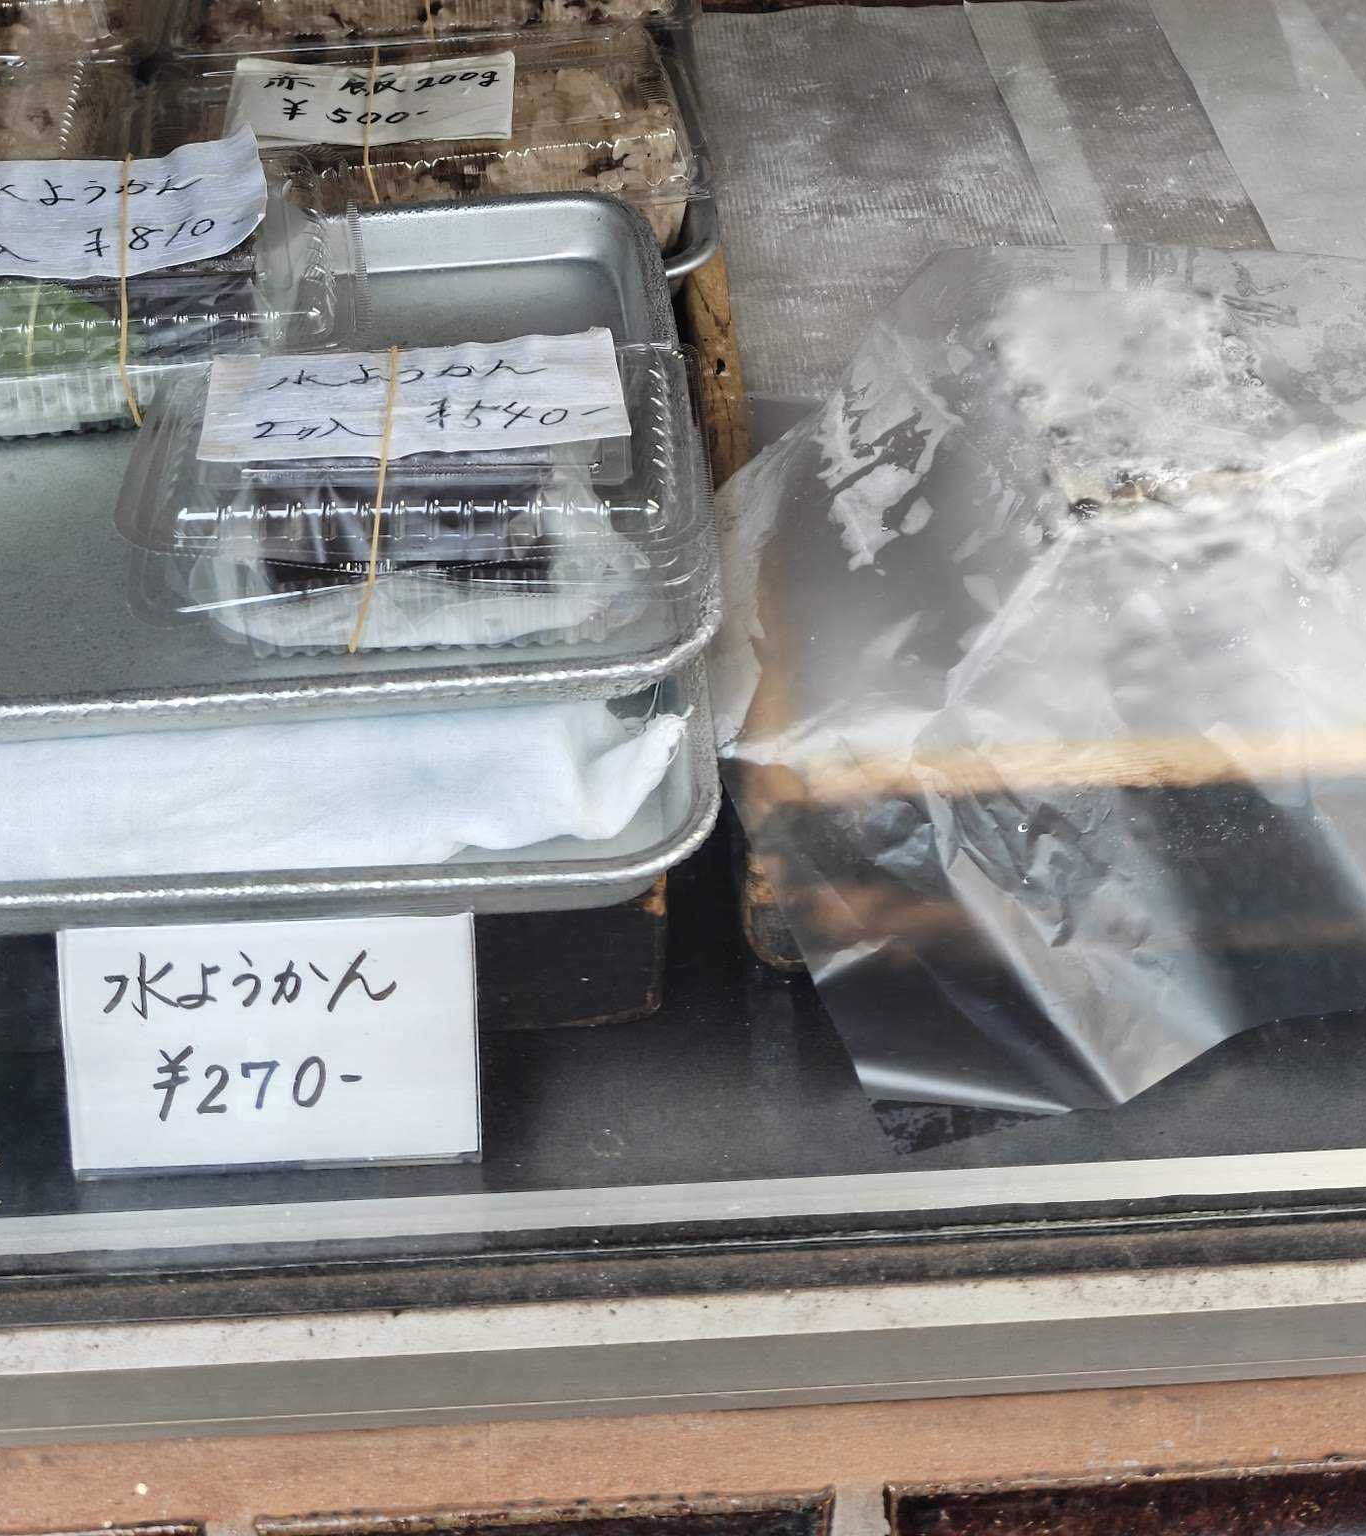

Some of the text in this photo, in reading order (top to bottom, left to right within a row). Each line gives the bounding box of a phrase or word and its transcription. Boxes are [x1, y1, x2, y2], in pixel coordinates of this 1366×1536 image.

[266, 358, 548, 392] 水ようかん
[102, 949, 398, 1020] 水ようかん
